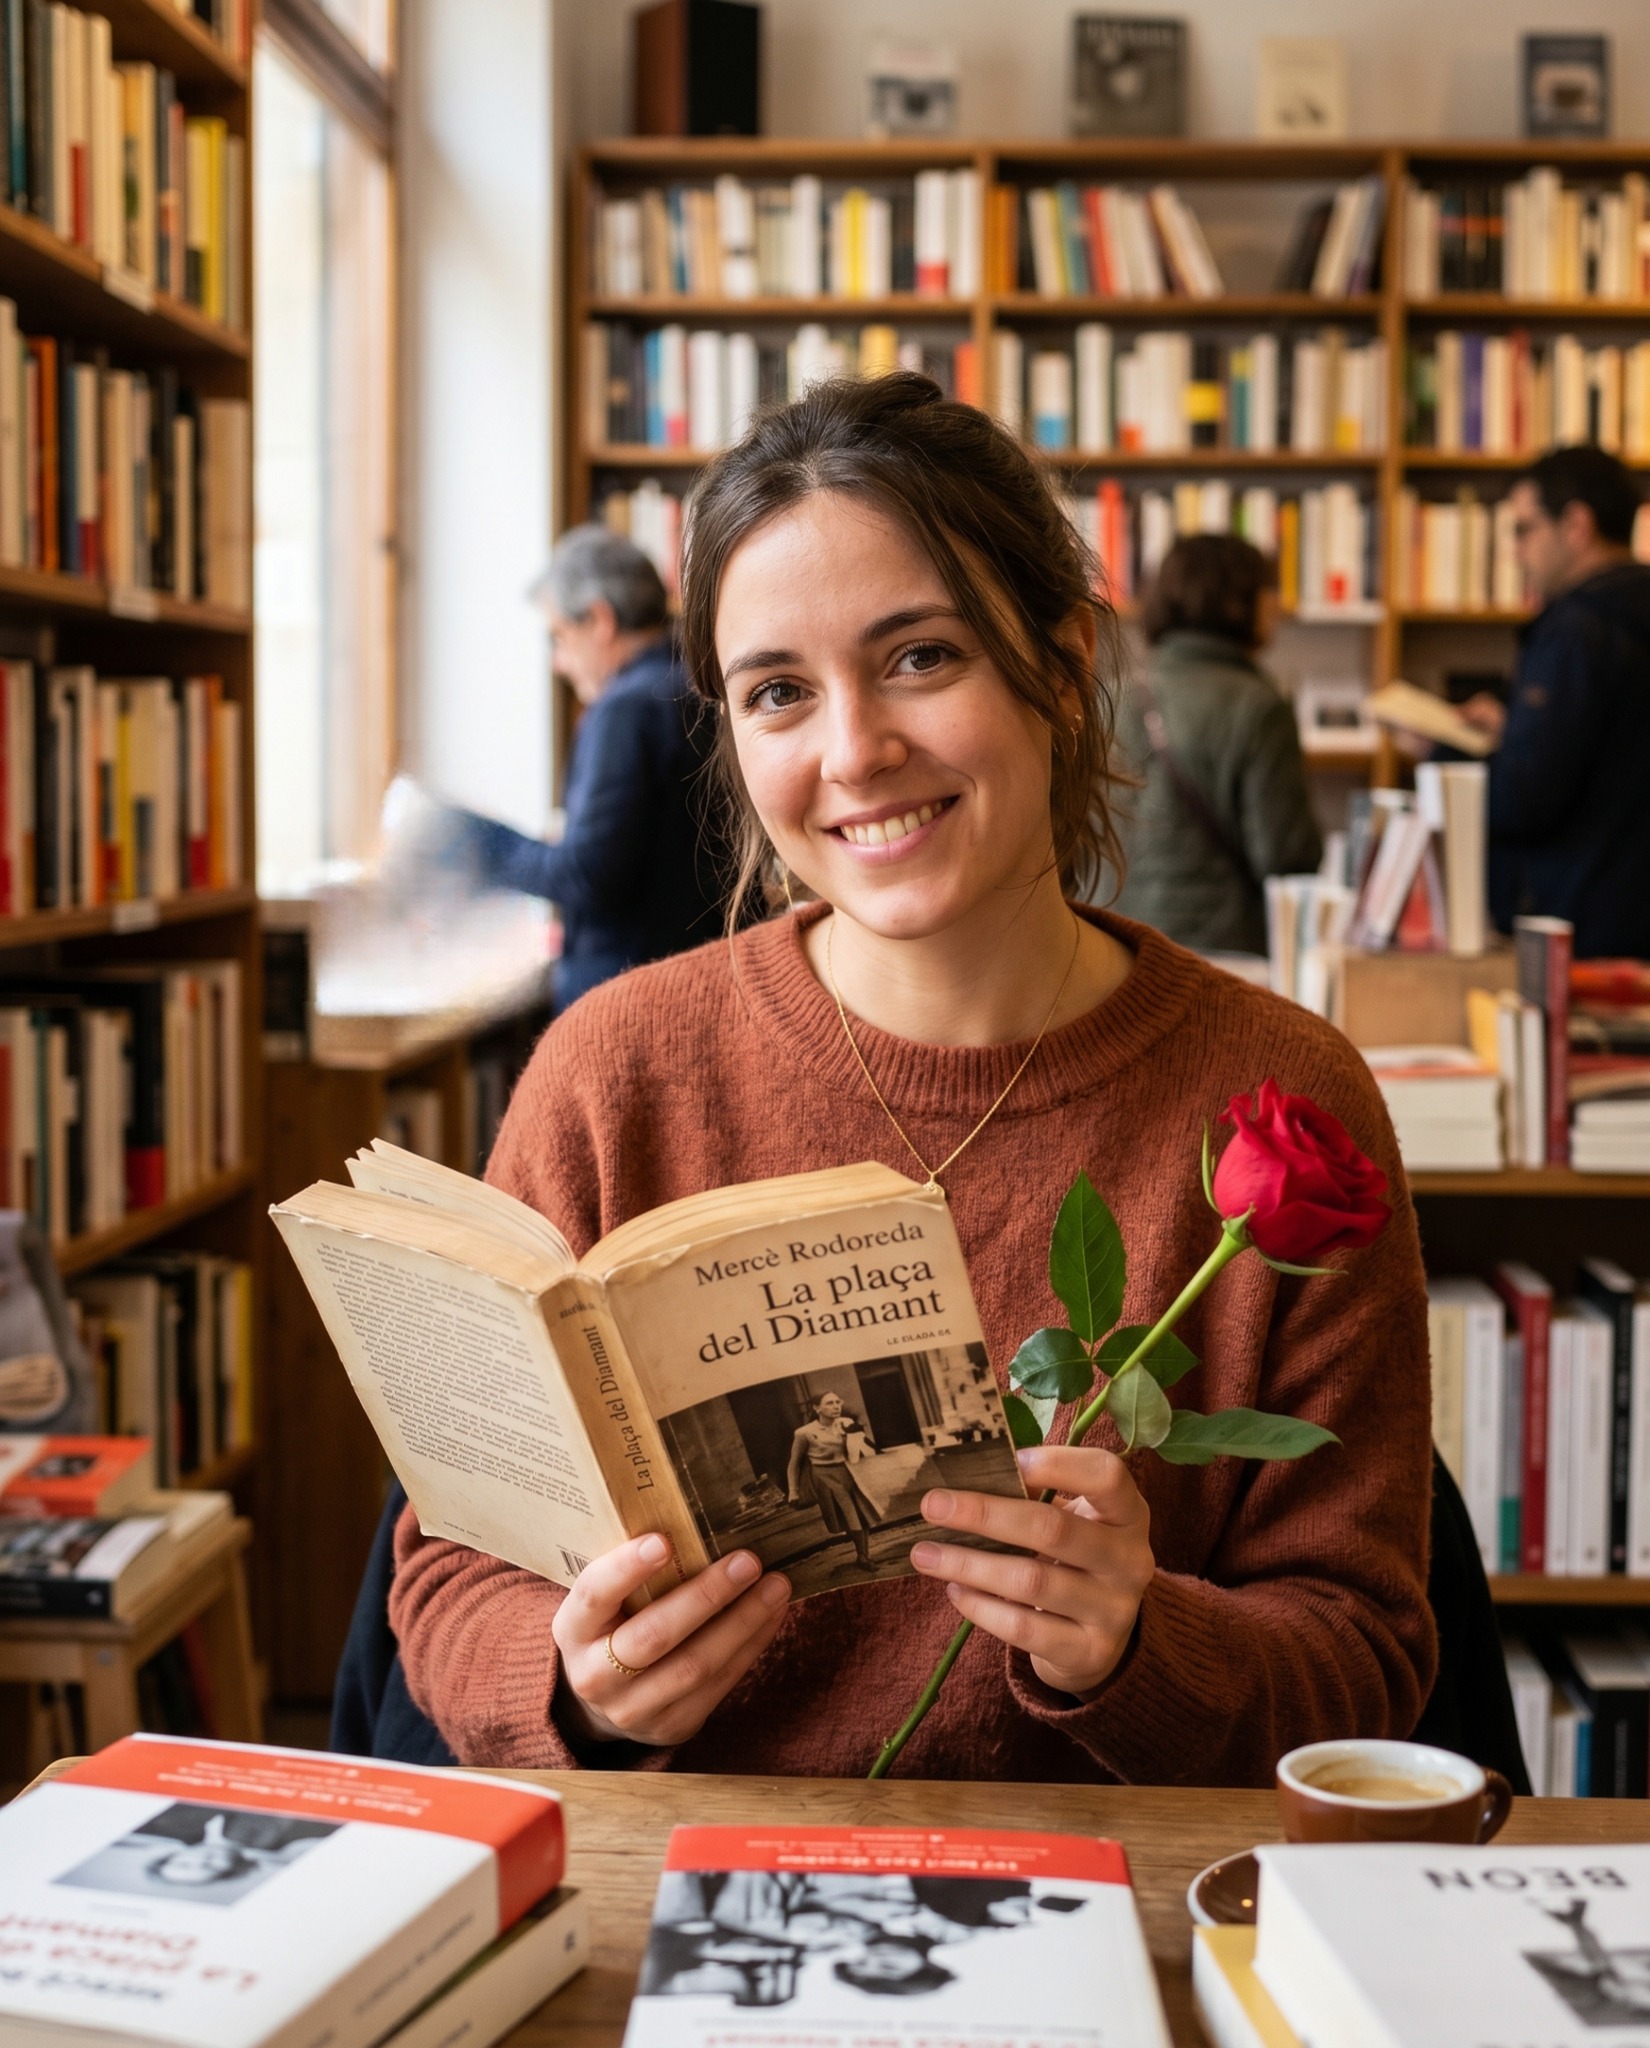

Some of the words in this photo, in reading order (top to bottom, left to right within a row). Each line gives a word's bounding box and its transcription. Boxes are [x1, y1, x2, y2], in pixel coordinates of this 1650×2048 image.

[693, 1248, 781, 1287] Mercè
[786, 1221, 925, 1263] Rodoreda
[759, 1280, 816, 1312] La
[826, 1259, 935, 1305] plaça
[698, 1322, 758, 1363] del
[765, 1289, 946, 1345] Diamant
[581, 1325, 619, 1394] Diamant
[605, 1398, 629, 1422] del
[621, 1424, 651, 1467] plaça
[636, 1468, 655, 1492] La
